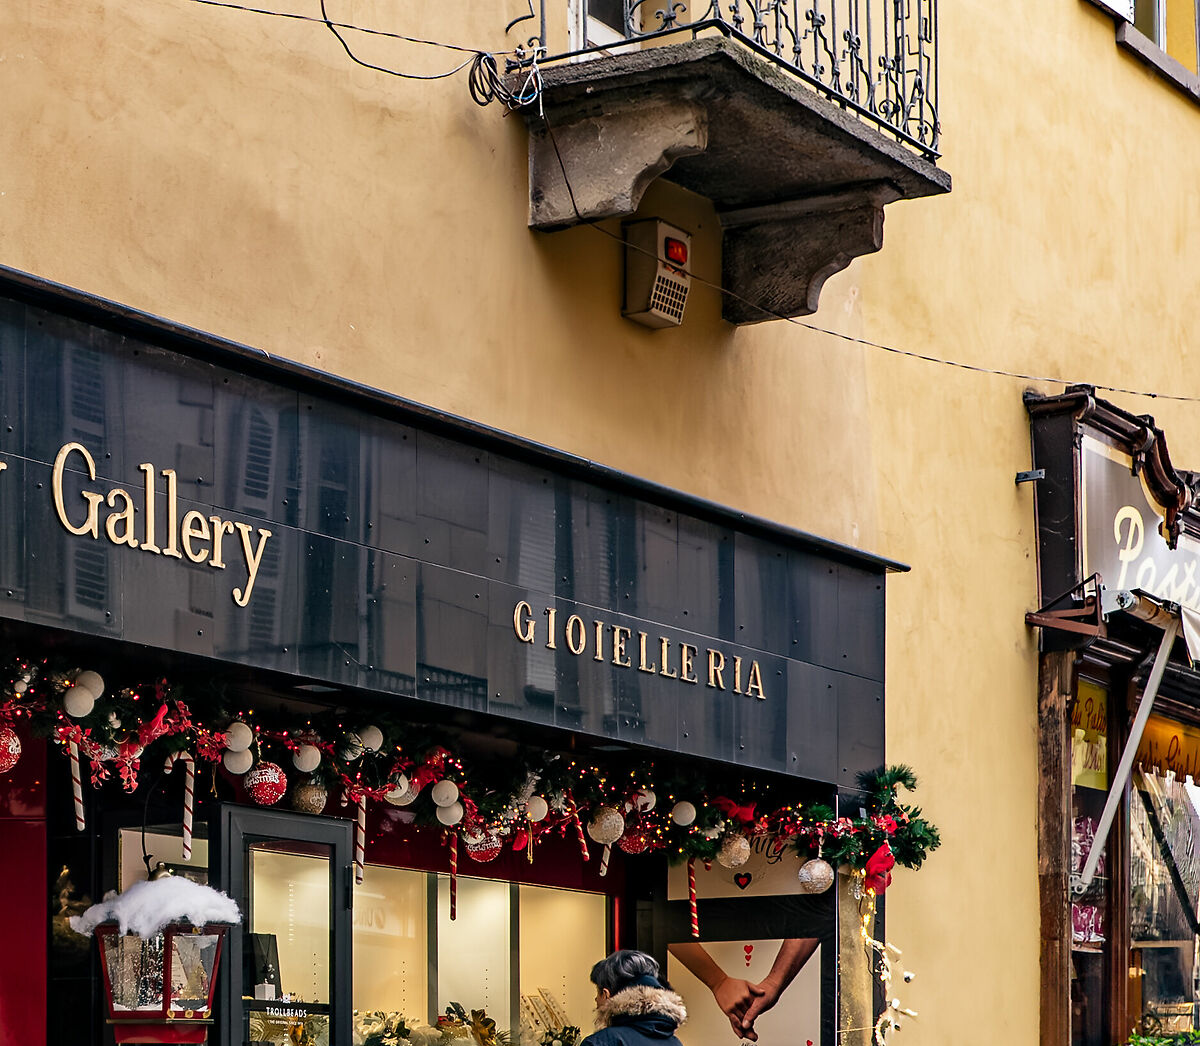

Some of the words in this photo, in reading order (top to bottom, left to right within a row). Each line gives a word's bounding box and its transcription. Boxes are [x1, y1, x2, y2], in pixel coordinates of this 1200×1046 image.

[51, 441, 272, 607] Gallery
[513, 600, 766, 699] GIOIELLERIA
[266, 1007, 307, 1018] TROLLBEADS
